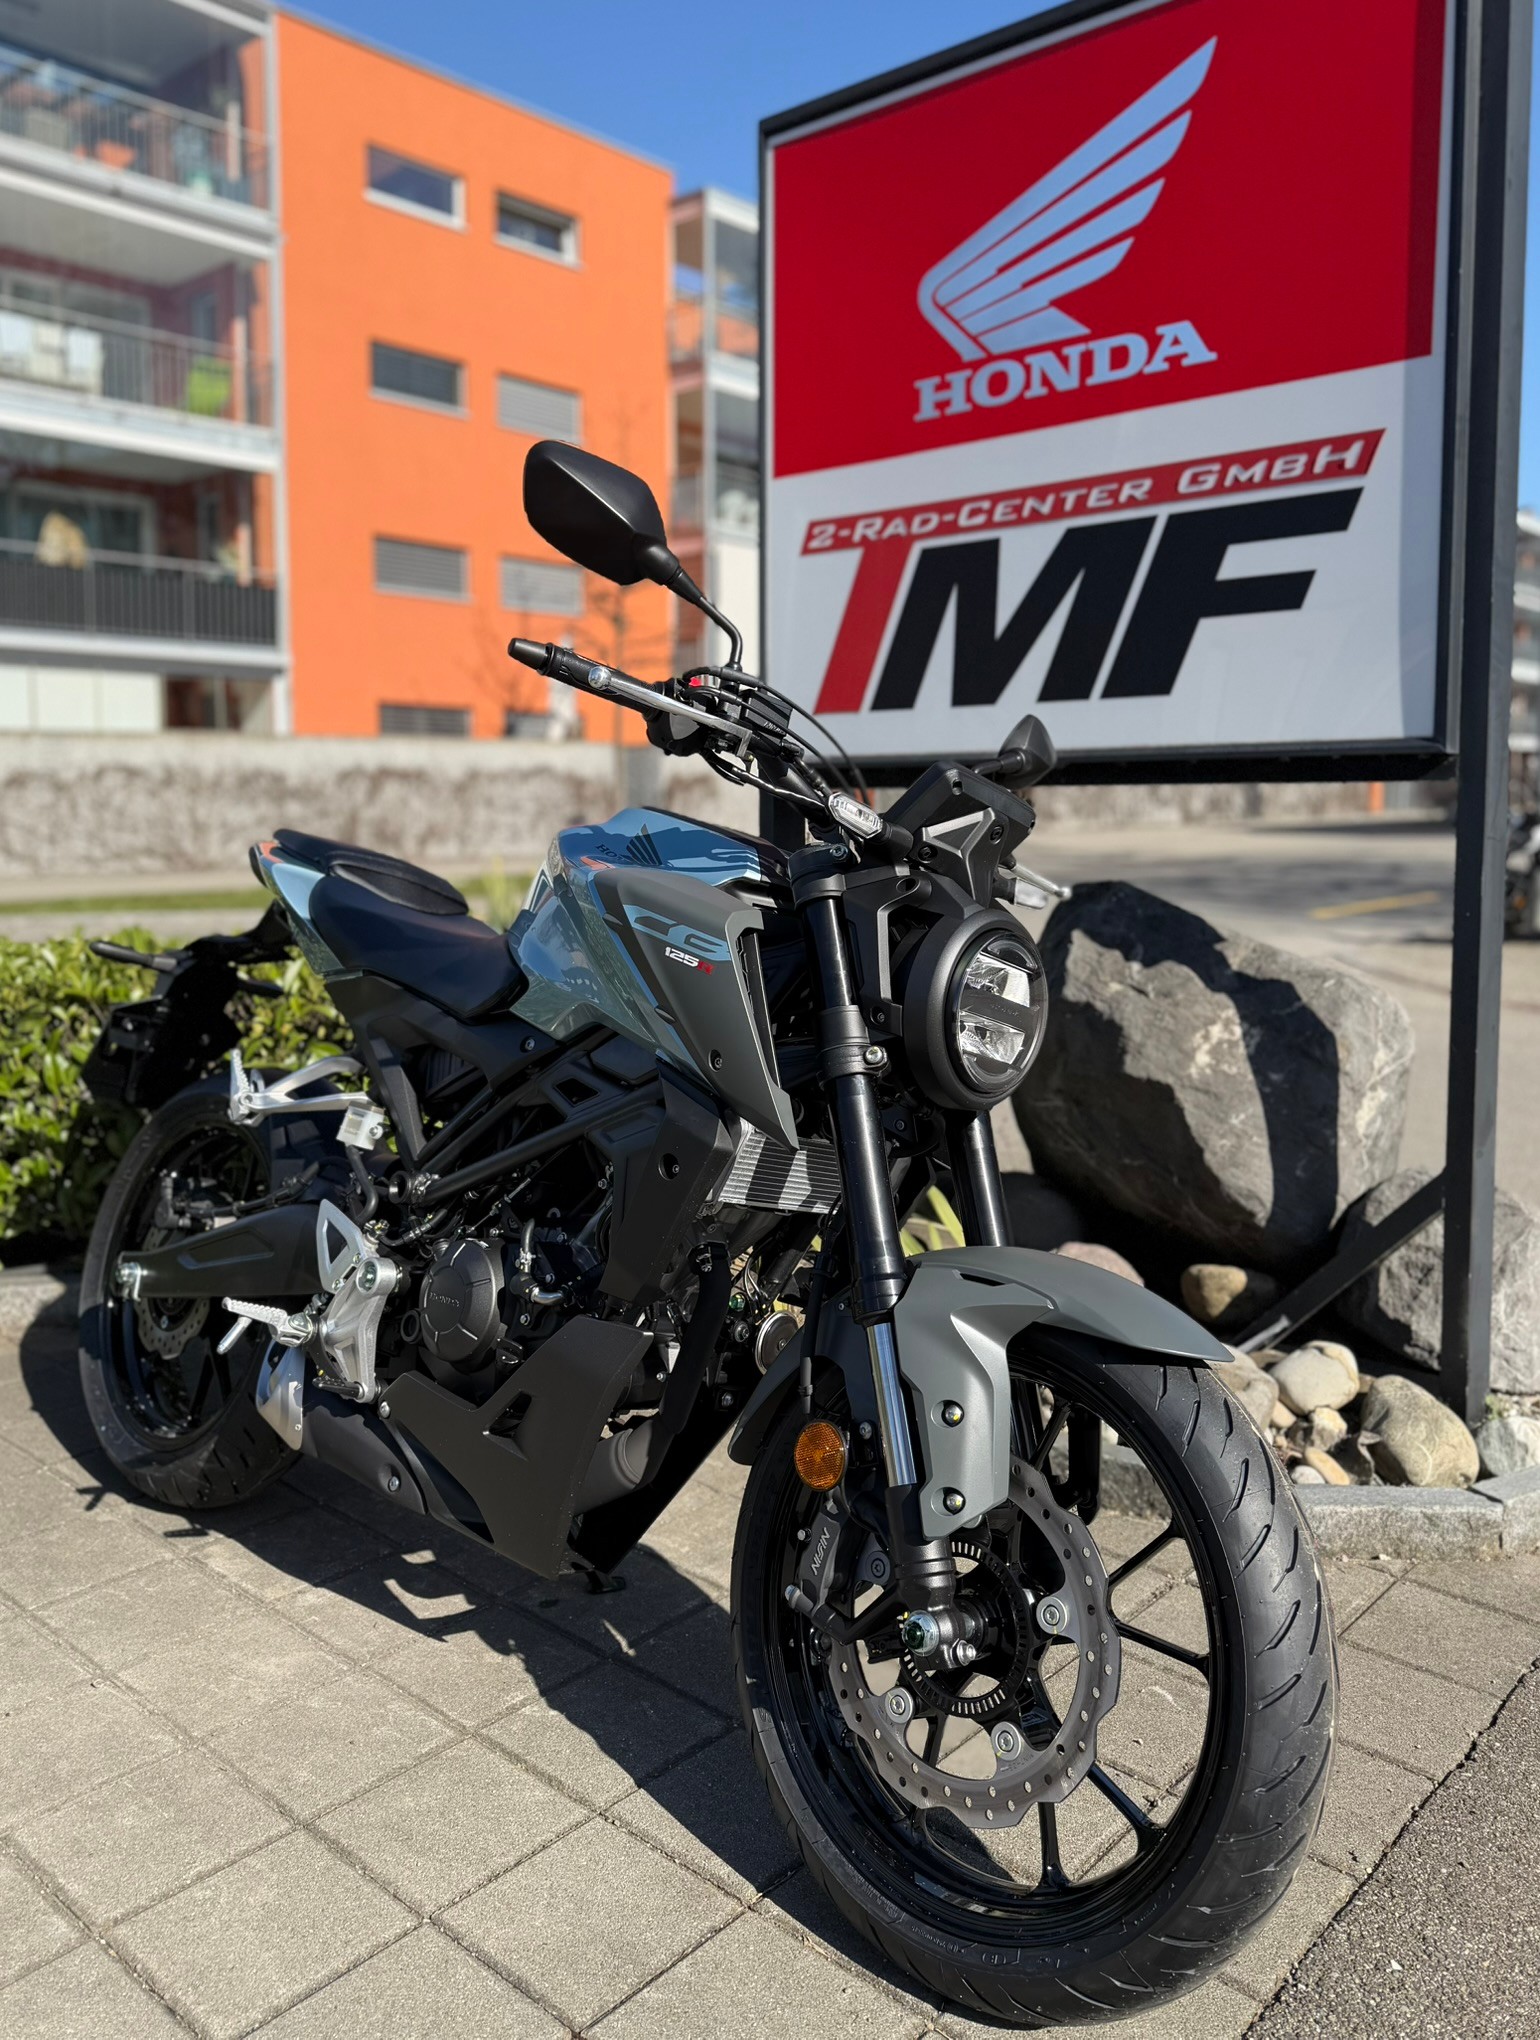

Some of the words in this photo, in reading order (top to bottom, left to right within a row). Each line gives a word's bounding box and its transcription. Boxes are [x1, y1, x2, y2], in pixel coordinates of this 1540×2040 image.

[913, 320, 1217, 423] HONDA
[802, 486, 1365, 715] TMF
[664, 946, 716, 976] 125R
